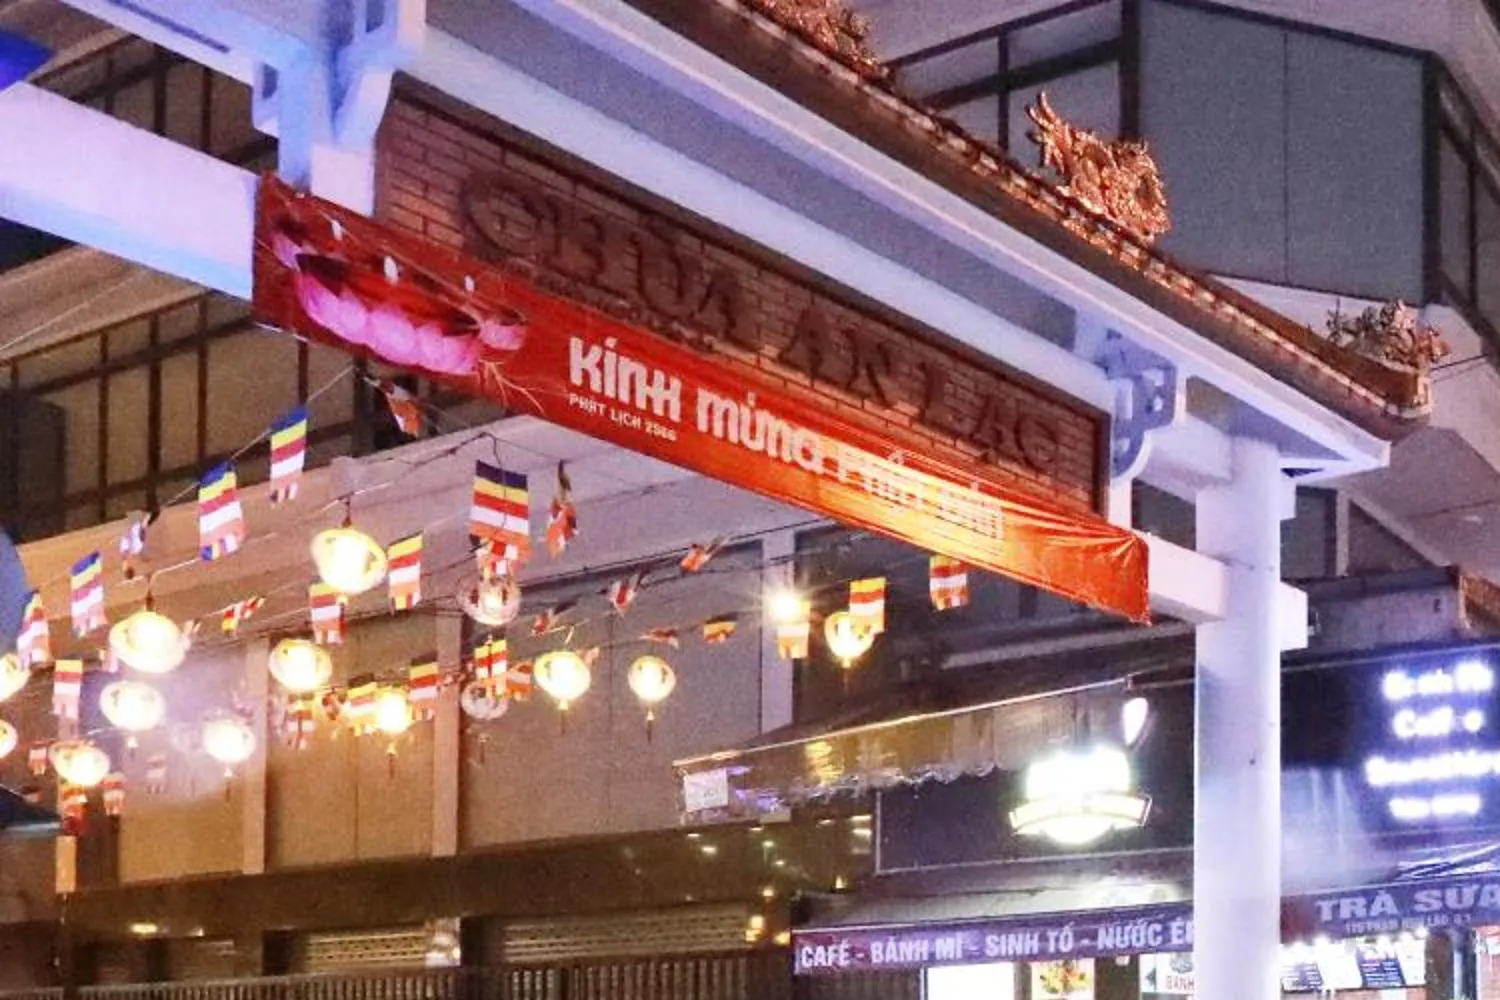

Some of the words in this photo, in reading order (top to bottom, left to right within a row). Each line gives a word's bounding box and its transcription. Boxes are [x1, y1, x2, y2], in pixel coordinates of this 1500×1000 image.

[1316, 889, 1399, 922] TRÀ
[801, 941, 851, 968] CAFÉ
[870, 935, 930, 964] BÁNH
[985, 930, 1039, 957] SINH
